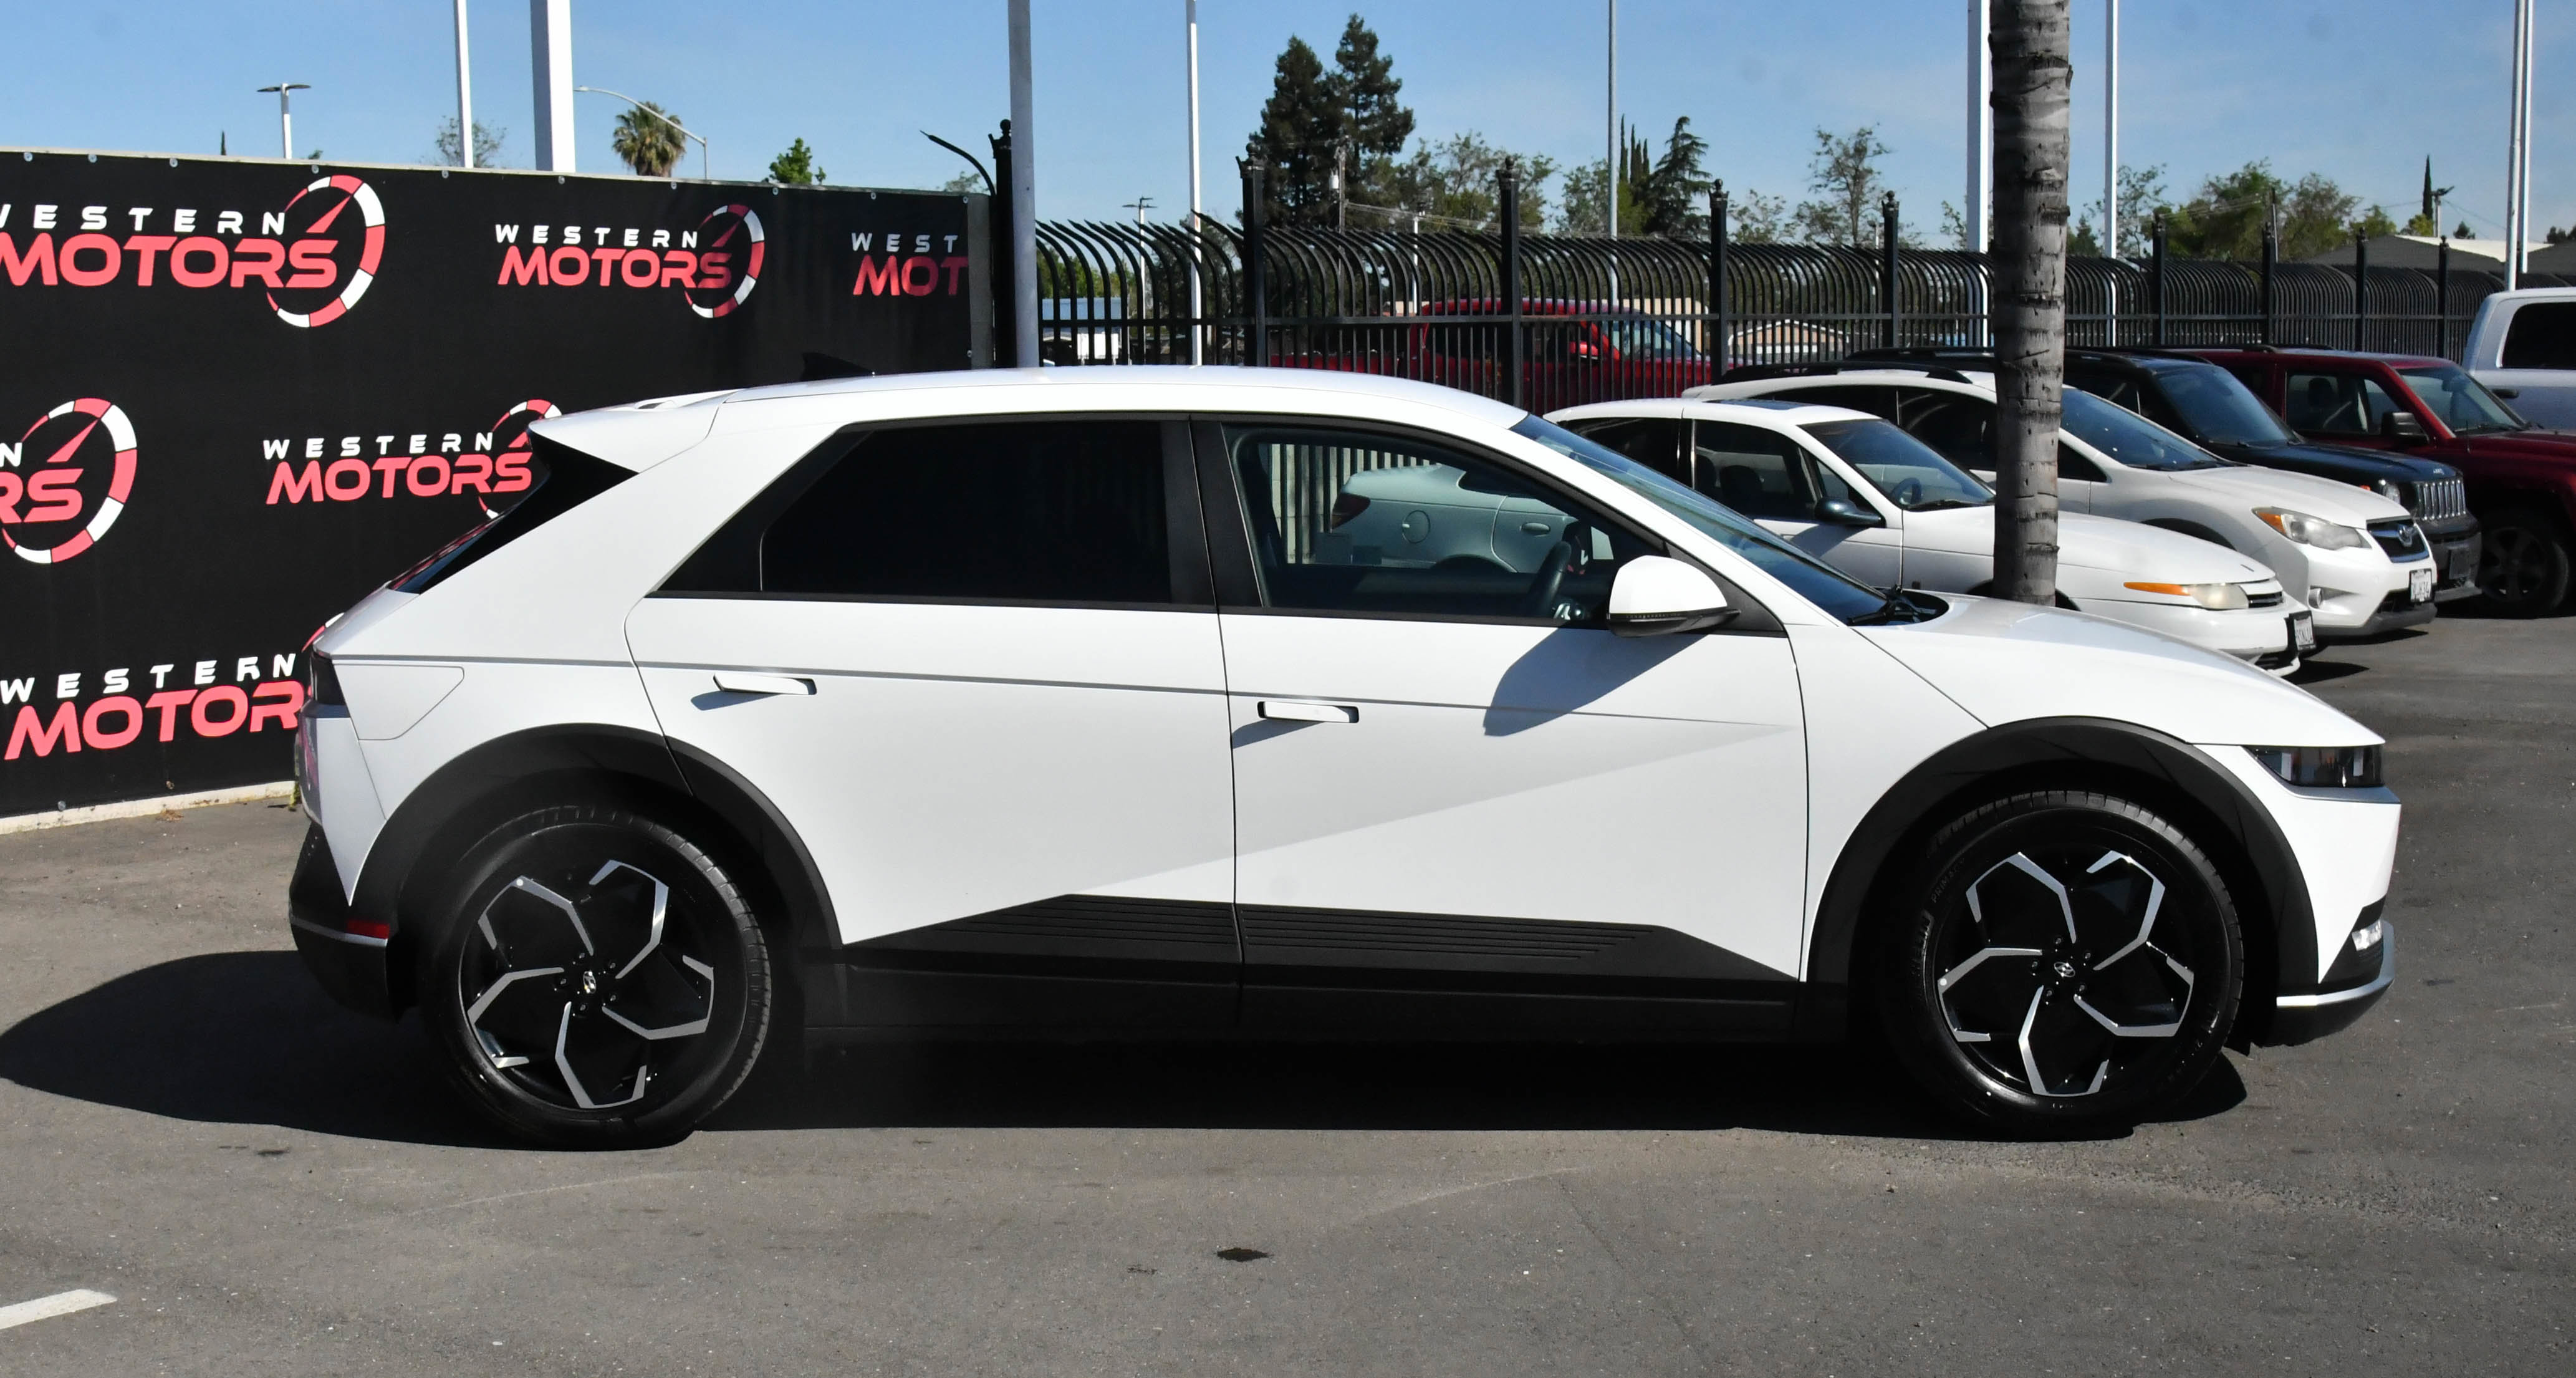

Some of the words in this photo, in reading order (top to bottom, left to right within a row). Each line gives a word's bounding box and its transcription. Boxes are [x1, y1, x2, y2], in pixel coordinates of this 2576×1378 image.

[495, 224, 698, 249] WESTERN
[851, 233, 958, 253] WEST
[0, 231, 339, 289] MOTORS
[497, 245, 732, 289] MOTORS
[852, 254, 968, 296] MOT
[262, 433, 493, 460] WESTERN
[265, 451, 534, 506] MOTORS
[0, 653, 296, 705] WESTERN
[3, 679, 312, 761] MOTOR
